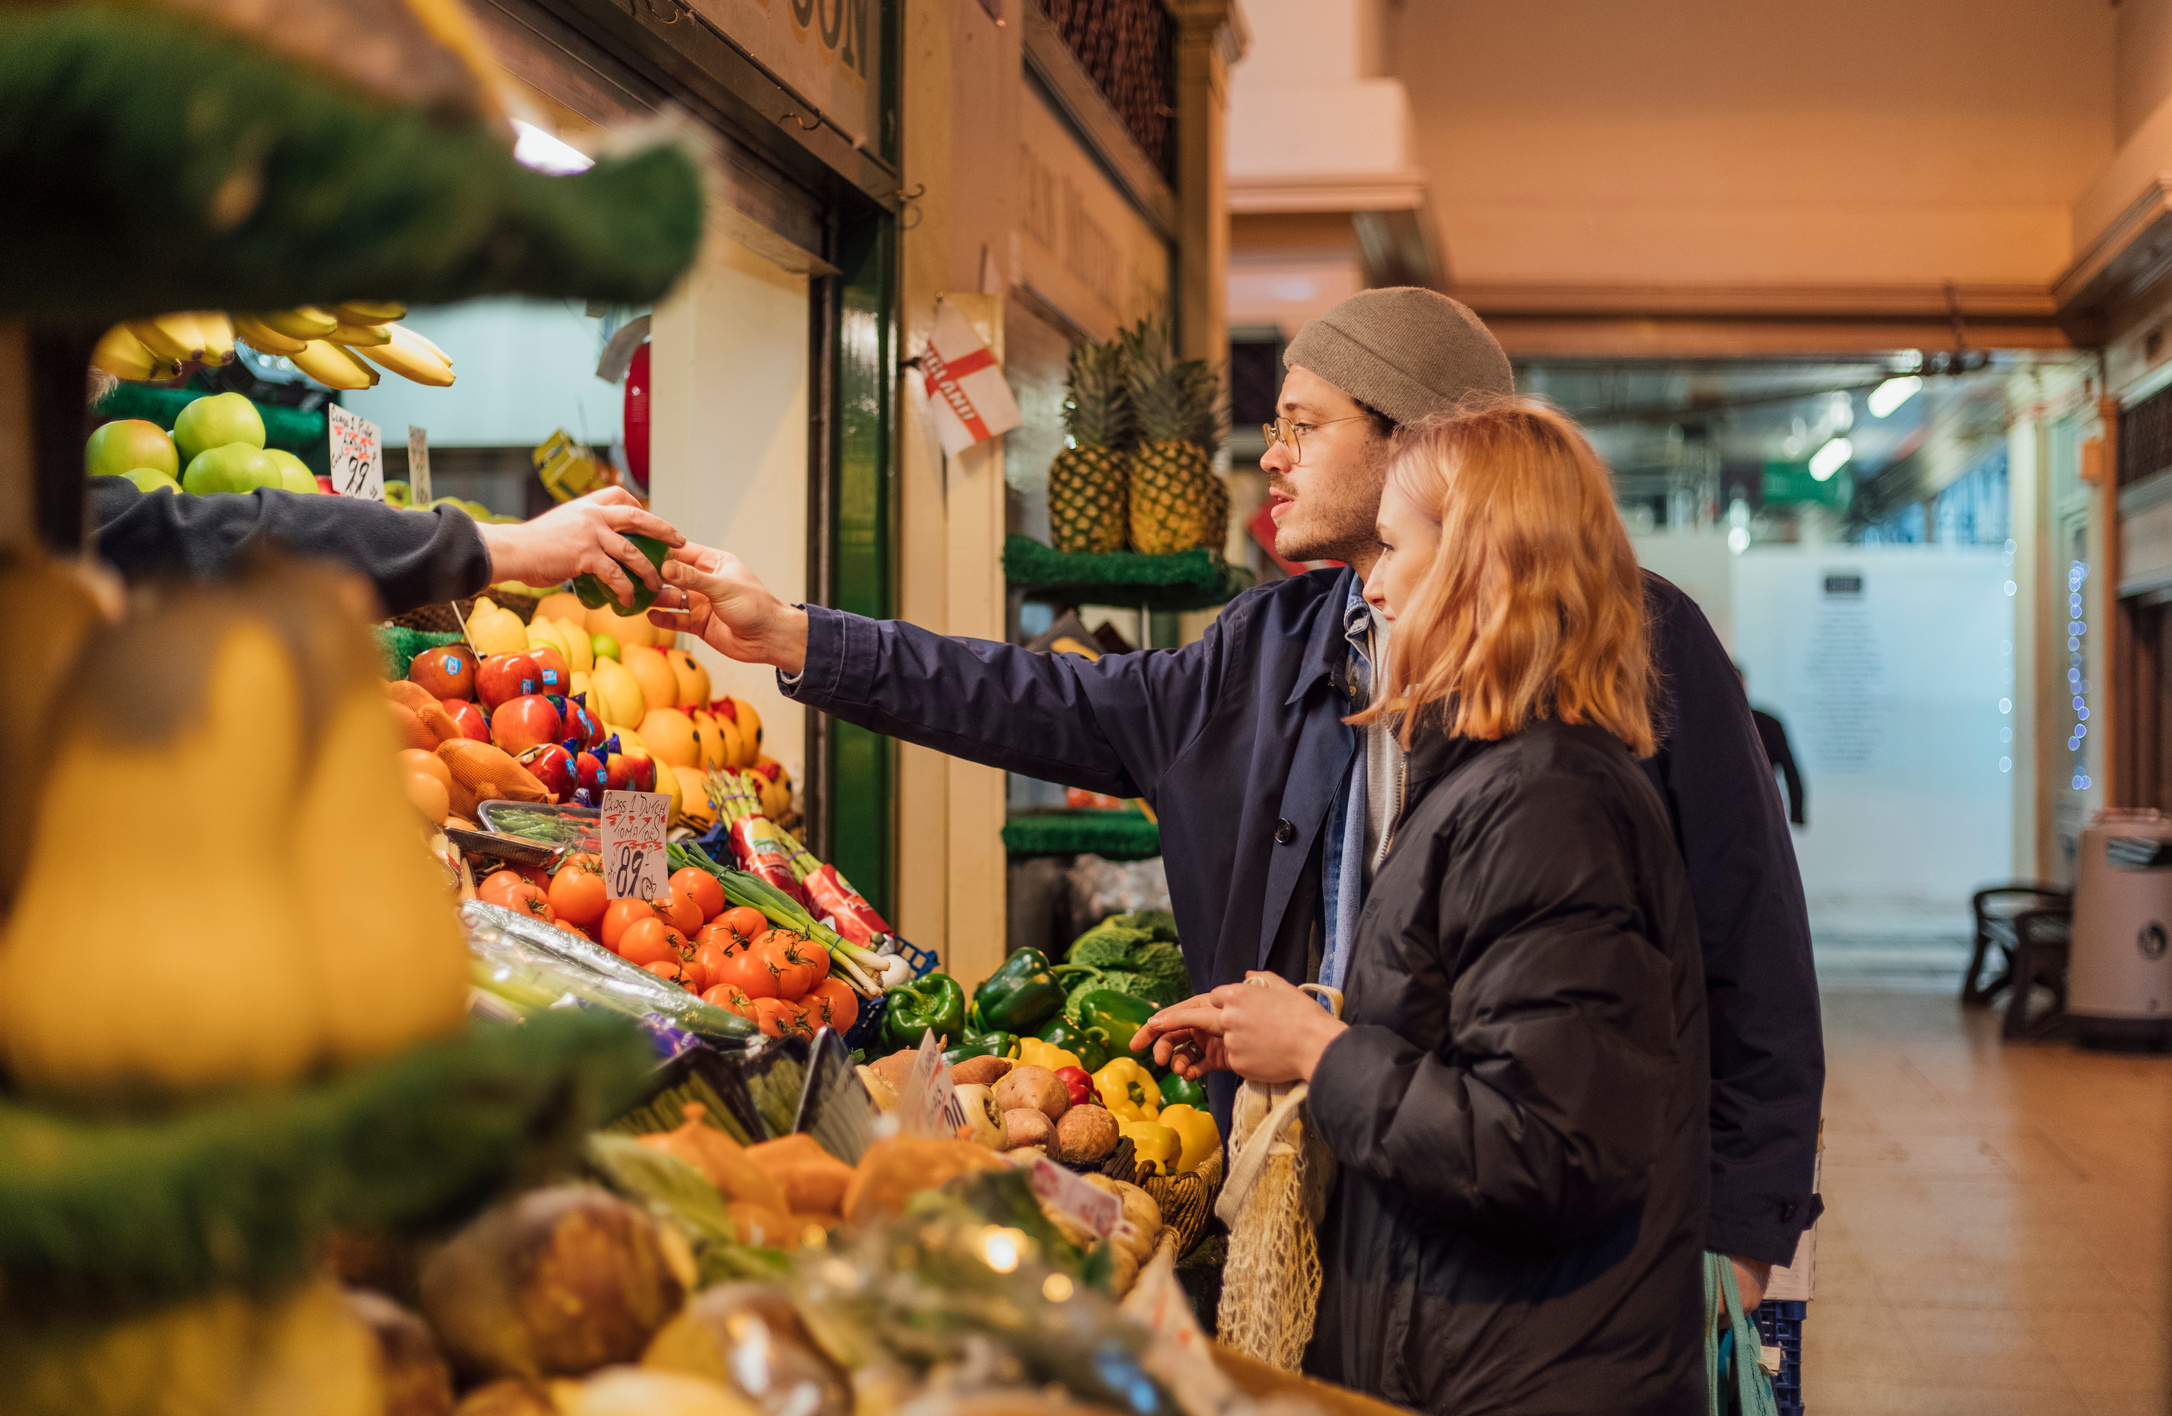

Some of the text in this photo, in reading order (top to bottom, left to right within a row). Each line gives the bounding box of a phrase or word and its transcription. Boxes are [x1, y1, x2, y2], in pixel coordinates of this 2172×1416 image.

[603, 791, 668, 817] CLASS 1 DUTCH
[613, 814, 661, 841] TOMATOES
